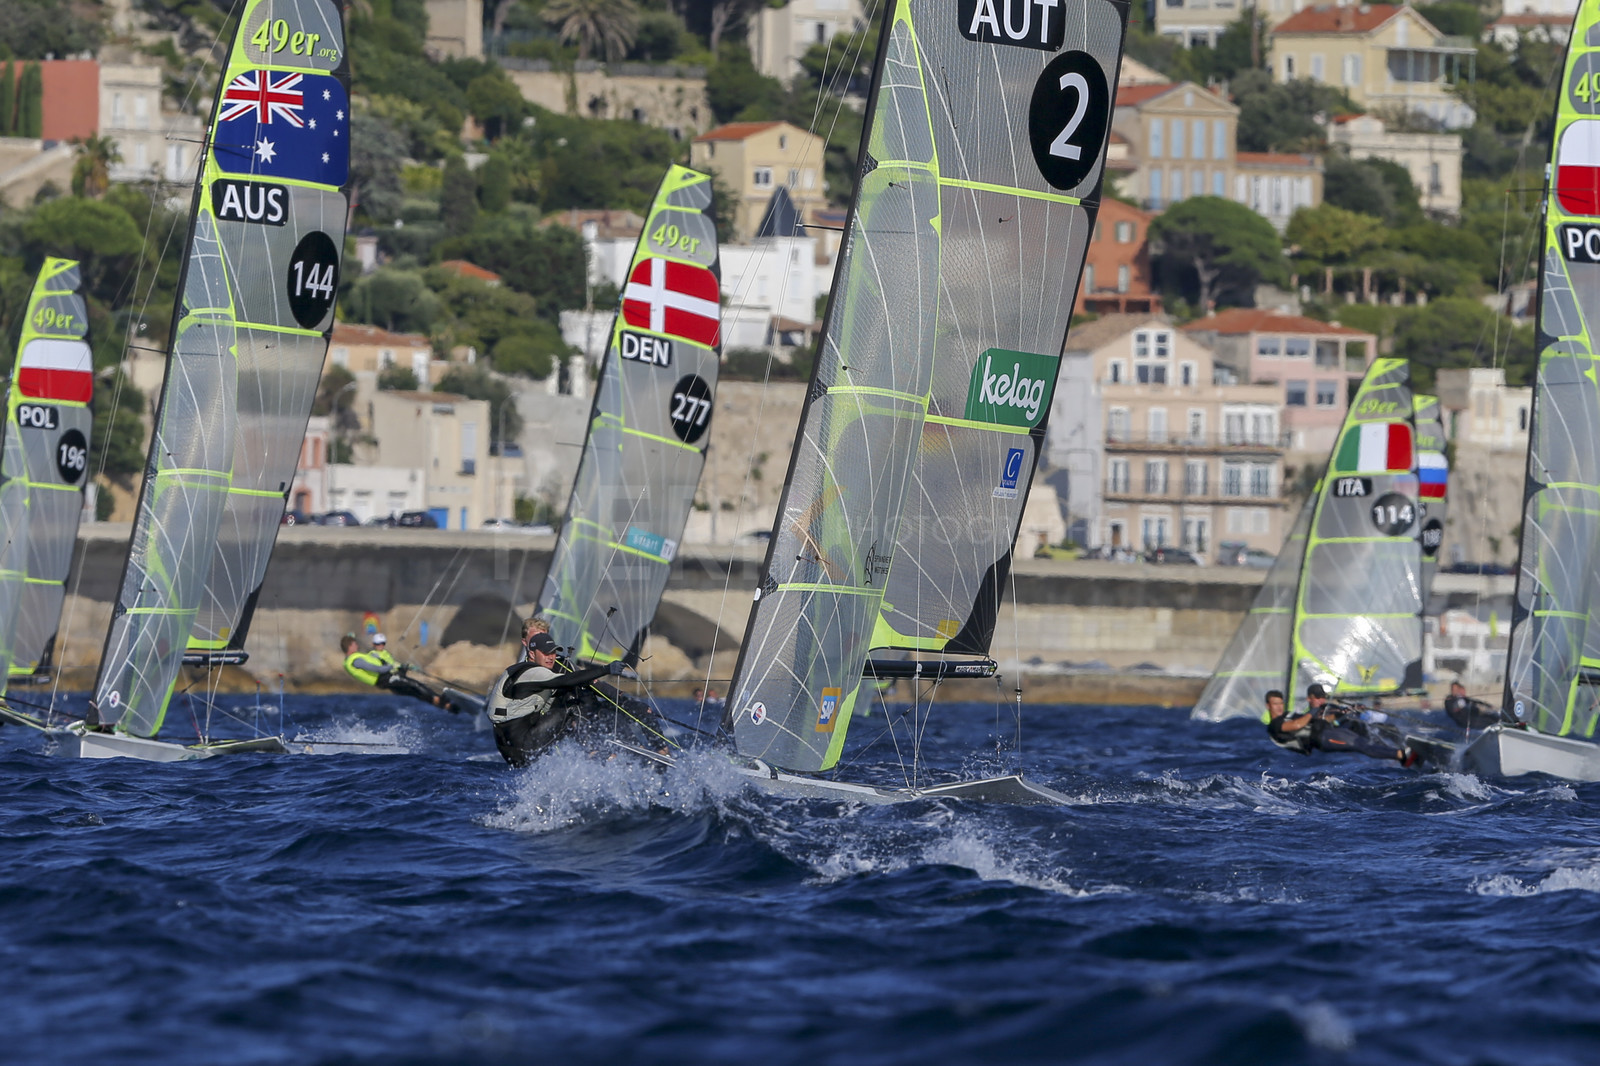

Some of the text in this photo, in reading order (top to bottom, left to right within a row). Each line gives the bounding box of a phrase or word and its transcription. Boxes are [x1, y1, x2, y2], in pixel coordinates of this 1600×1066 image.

[969, 0, 1058, 43] AUT
[1050, 72, 1089, 161] 2
[220, 184, 283, 222] AUS
[652, 223, 701, 254] 49er
[294, 260, 334, 300] 144
[33, 307, 74, 329] 49er
[622, 333, 670, 366] DEN
[979, 355, 1045, 421] kelag
[20, 405, 55, 429] POL
[671, 392, 711, 426] 277
[60, 443, 86, 471] 196
[1337, 478, 1366, 497] ITA
[1374, 504, 1413, 525] 114
[820, 700, 835, 720] SAP
